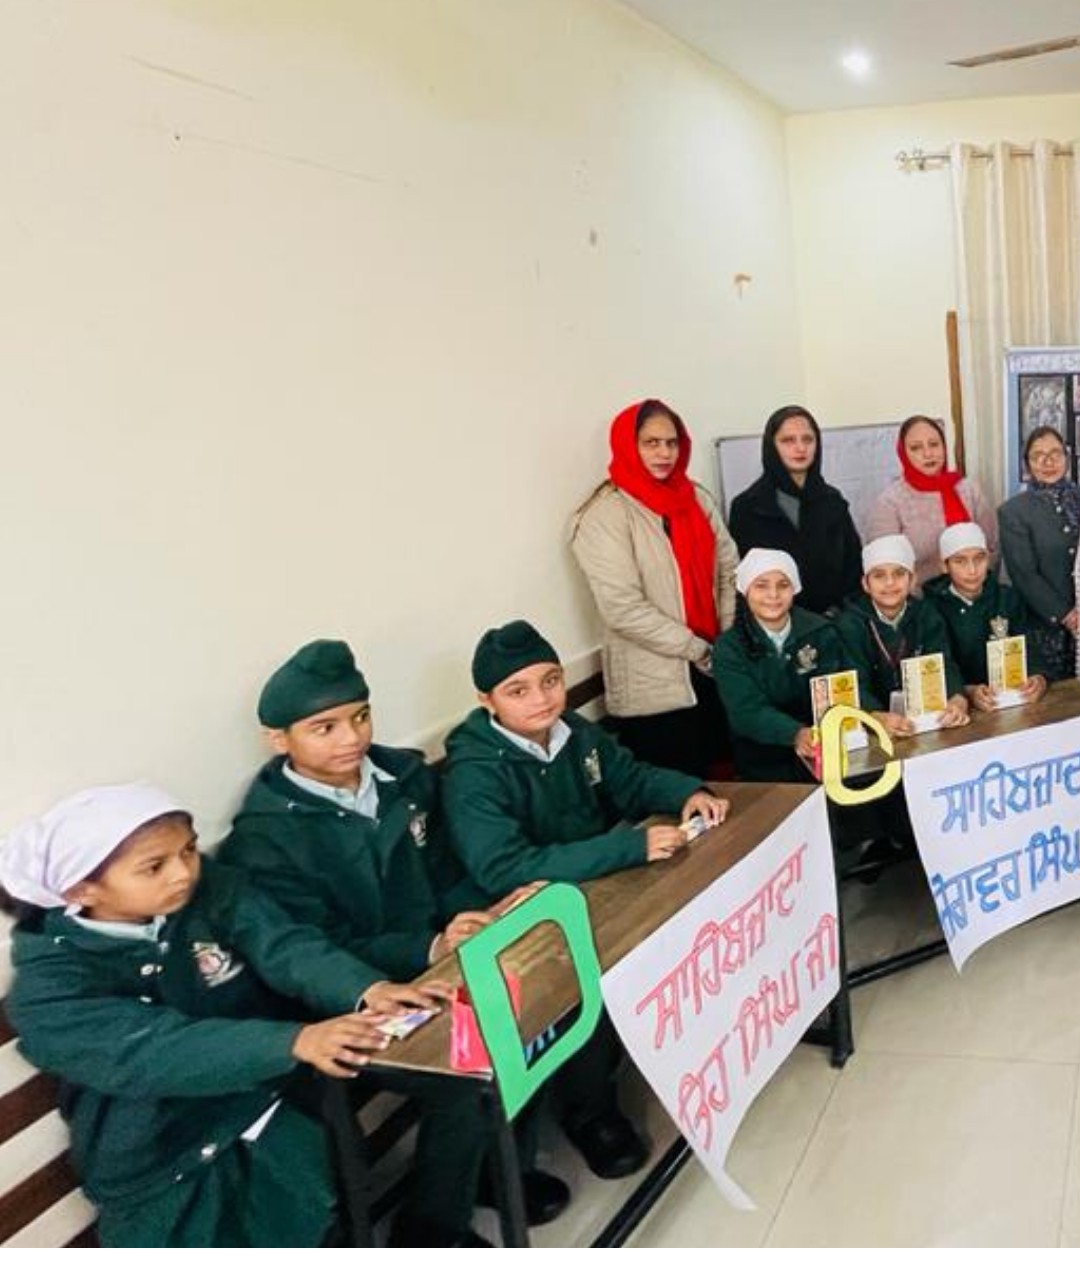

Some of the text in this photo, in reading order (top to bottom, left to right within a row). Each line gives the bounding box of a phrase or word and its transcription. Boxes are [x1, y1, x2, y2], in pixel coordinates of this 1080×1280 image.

[821, 704, 902, 806] C
[457, 881, 603, 1123] D
[806, 911, 838, 992] ਜੀ
